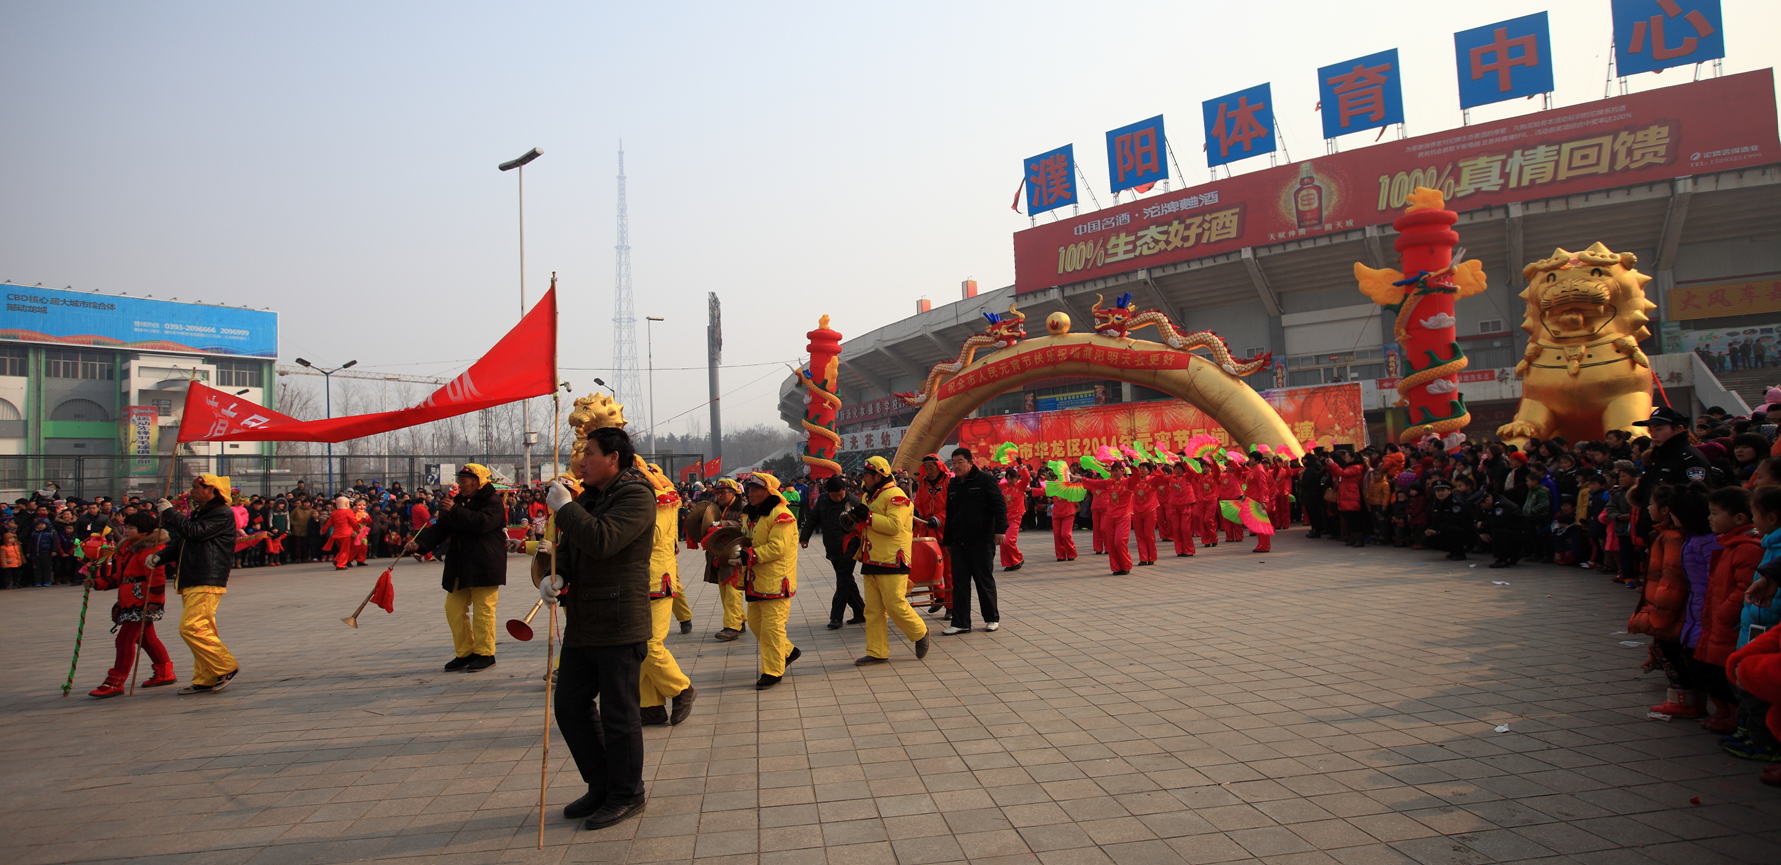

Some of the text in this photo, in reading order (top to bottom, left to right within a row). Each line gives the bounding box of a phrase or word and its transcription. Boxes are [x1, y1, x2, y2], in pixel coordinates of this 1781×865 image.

[1377, 125, 1670, 210] 100%真情回馈
[1057, 207, 1240, 274] 100%生态好酒
[841, 430, 906, 451] 光花幼
